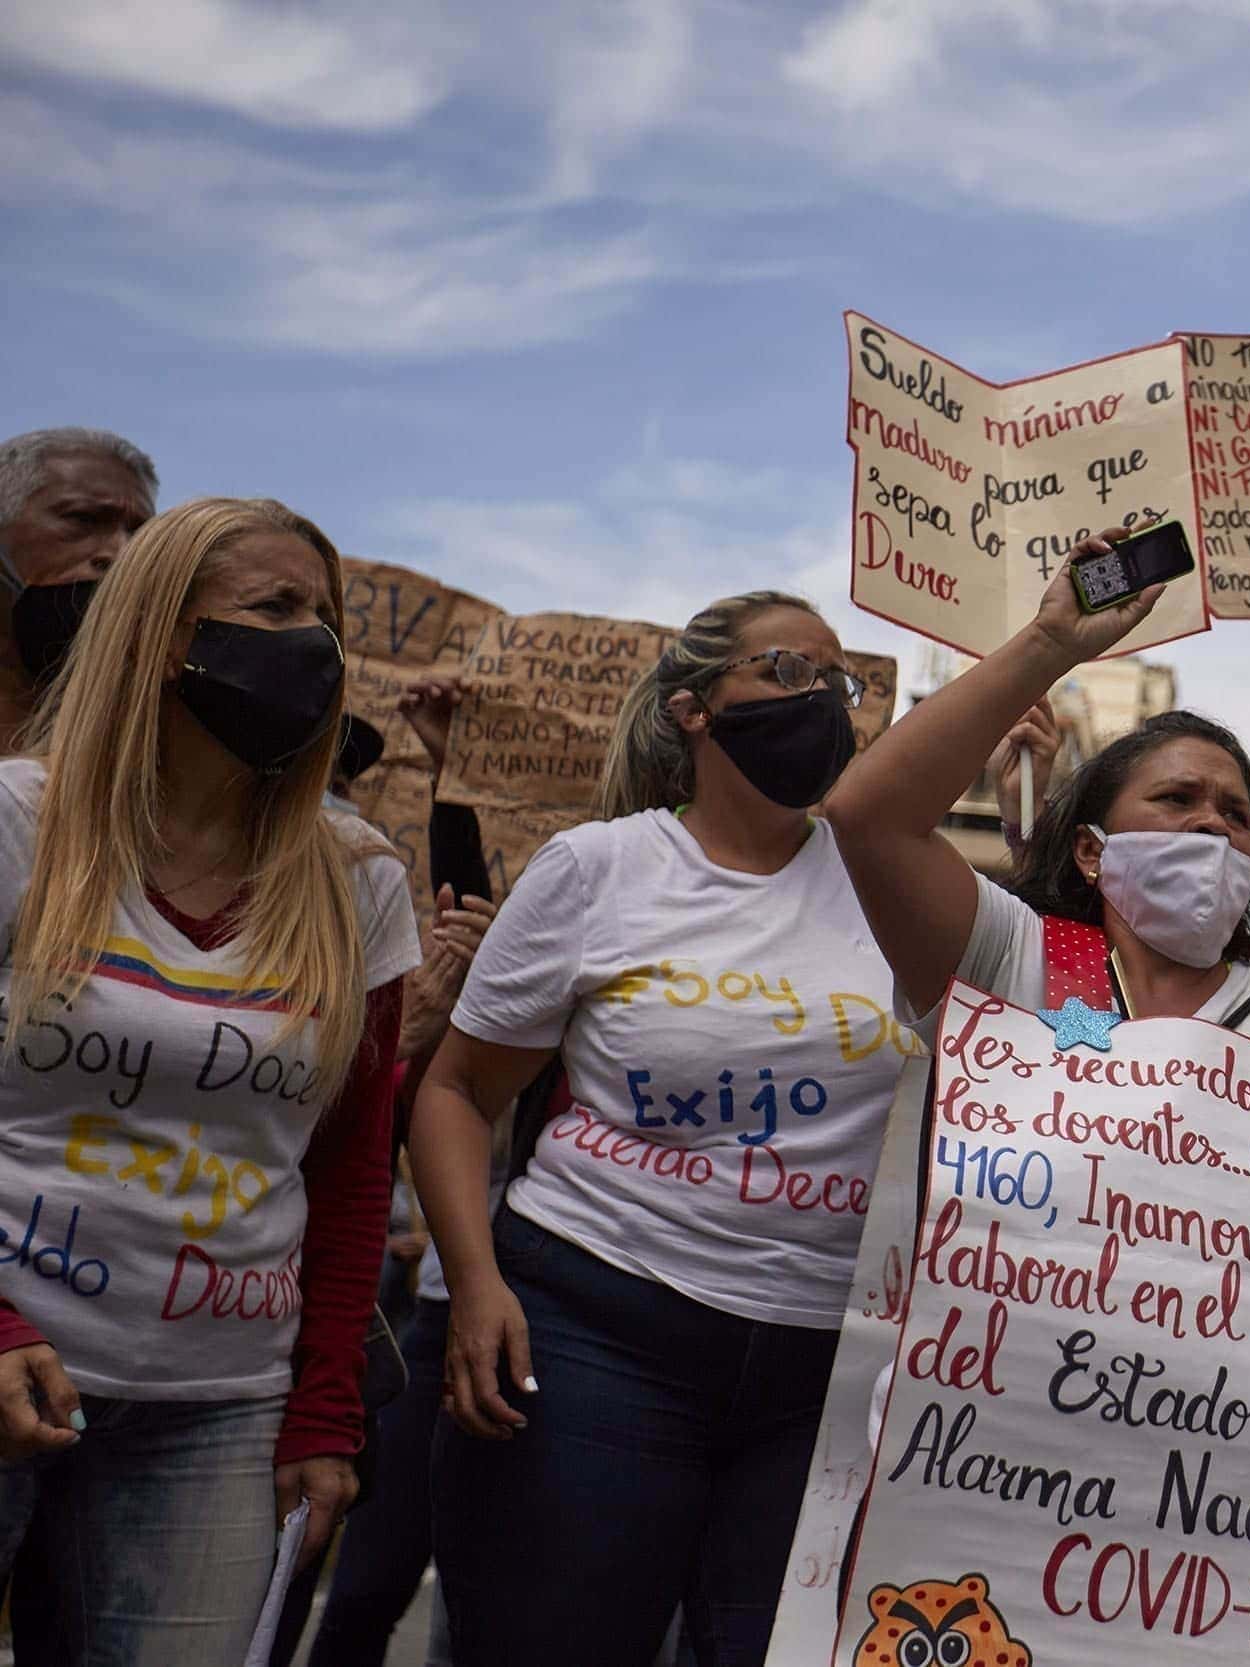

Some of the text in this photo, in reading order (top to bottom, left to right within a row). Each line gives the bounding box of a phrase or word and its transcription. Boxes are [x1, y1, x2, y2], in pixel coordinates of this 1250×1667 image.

[860, 327, 1175, 448] Sueldo mínimo a
[1193, 405, 1218, 433] Ni
[1087, 449, 1149, 504] que
[1196, 438, 1226, 469] Ni
[1200, 469, 1230, 500] Ni
[860, 511, 960, 605] Duro.
[970, 502, 1005, 557] lo
[1204, 533, 1234, 558] mi
[476, 655, 513, 675] DE
[534, 687, 572, 712] NO
[464, 717, 550, 743] DIGNO
[942, 995, 1041, 1084] Les
[627, 1067, 827, 1145] Exijo
[937, 1076, 1024, 1134] los
[64, 1113, 271, 1240] Exijo
[937, 1135, 1058, 1230] 4160,
[920, 1196, 1120, 1317] laboral
[1130, 1279, 1187, 1340] en
[1196, 1260, 1246, 1342] el
[908, 1302, 1009, 1397] del
[888, 1402, 1116, 1525] Alarma
